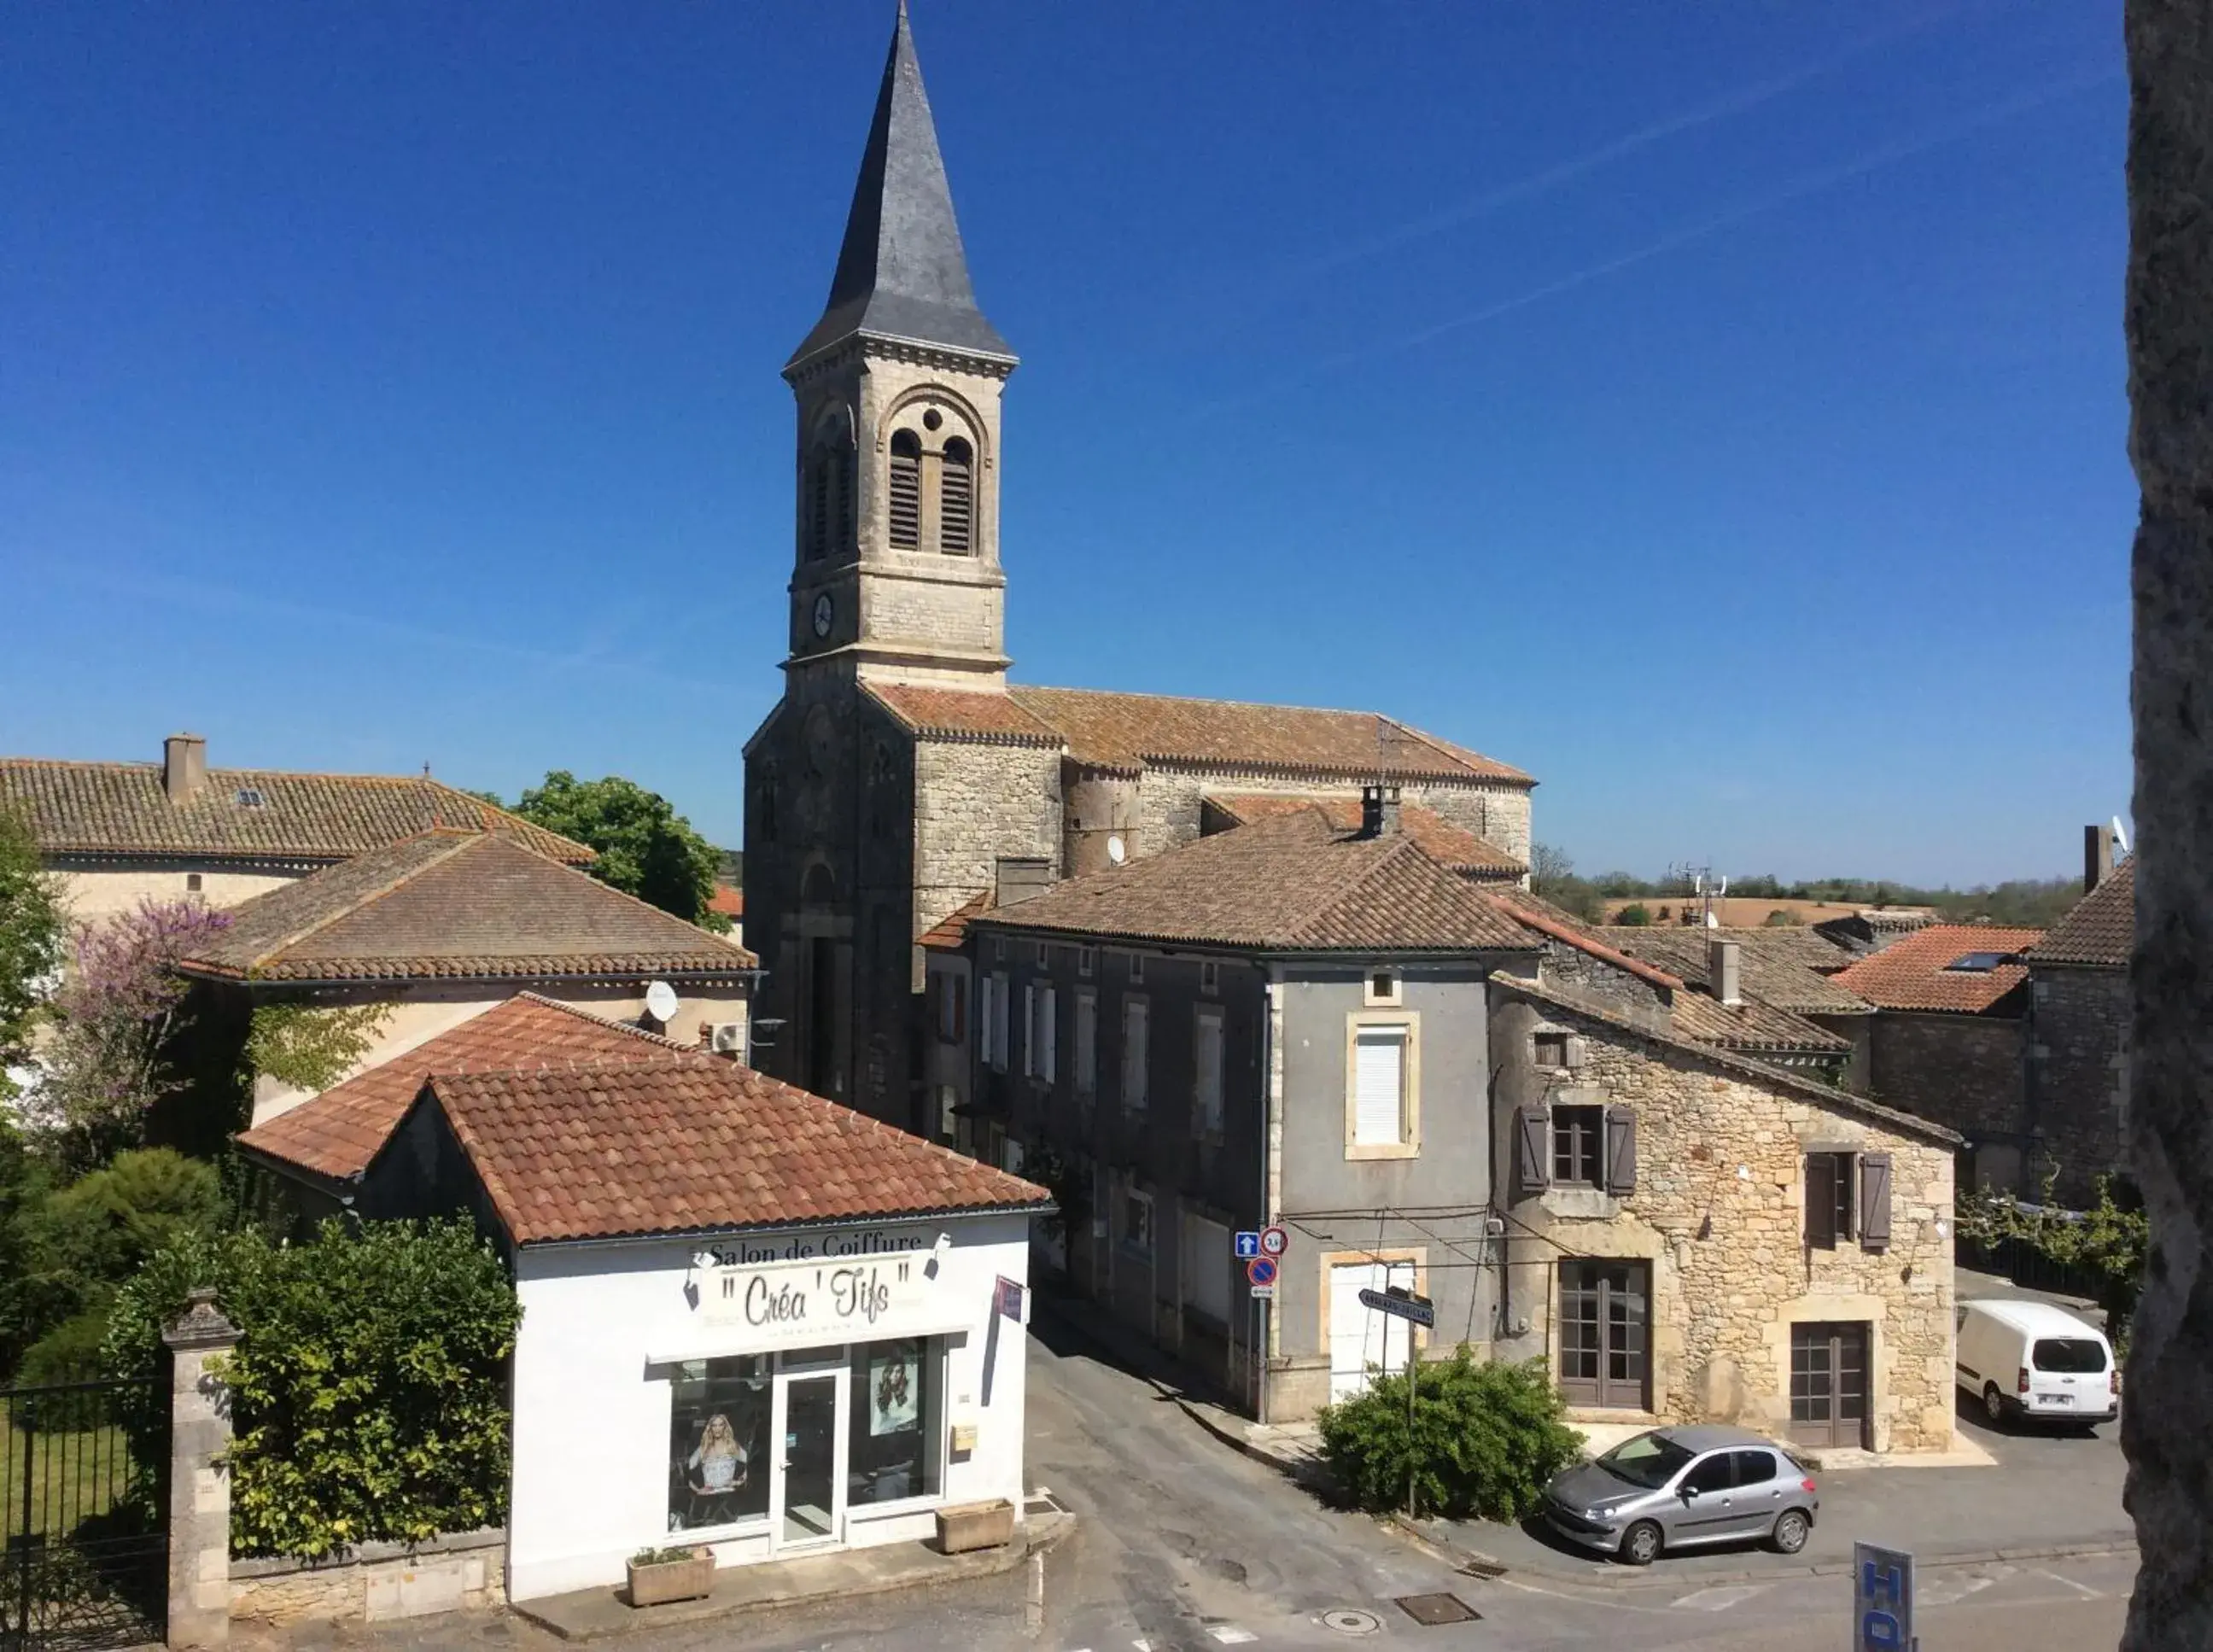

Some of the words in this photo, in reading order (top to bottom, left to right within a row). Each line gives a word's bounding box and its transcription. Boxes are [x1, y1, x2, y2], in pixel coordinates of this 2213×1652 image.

[710, 1241, 775, 1265] Salon
[785, 1238, 814, 1260] de
[822, 1230, 922, 1258] Coiffure
[830, 1267, 889, 1326] Tifs
